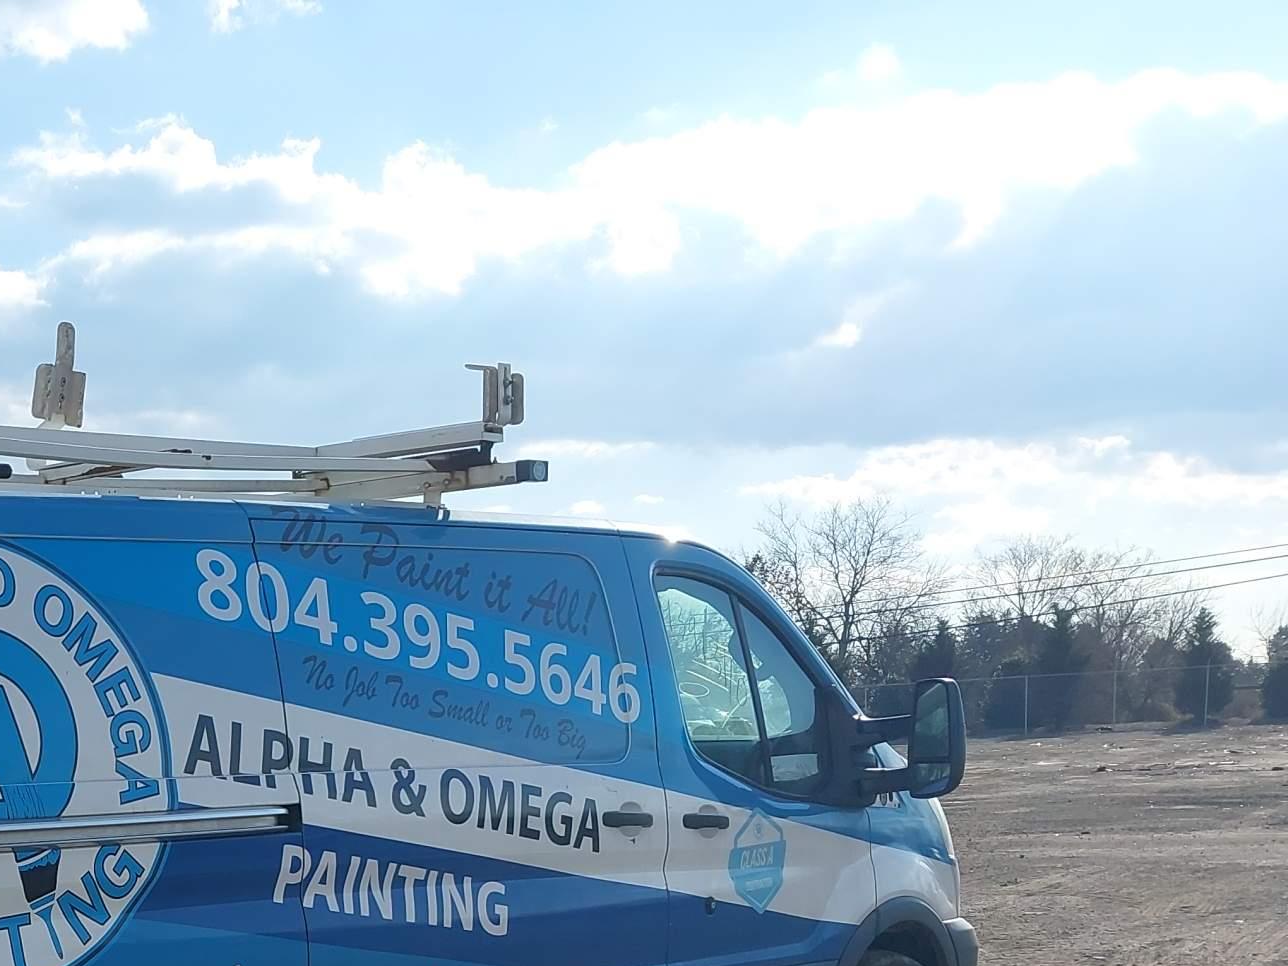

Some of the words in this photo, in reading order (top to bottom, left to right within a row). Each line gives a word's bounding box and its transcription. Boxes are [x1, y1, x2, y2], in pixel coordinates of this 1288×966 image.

[195, 548, 642, 724] 804.395.5646
[270, 506, 344, 565] We
[360, 524, 470, 600] Paint
[485, 571, 512, 613] it
[521, 578, 597, 636] All!
[33, 584, 160, 805] OMEGA
[303, 655, 335, 691] No
[342, 666, 379, 707] Job
[385, 675, 420, 711] Too
[428, 689, 489, 728] Small
[495, 712, 513, 732] or
[520, 708, 550, 741] Too
[557, 718, 587, 760] Big
[183, 714, 377, 808] ALPHA
[390, 758, 427, 818] &
[439, 768, 600, 854] OMEGA
[272, 844, 508, 936] PAINTING
[741, 847, 767, 870] CLASS
